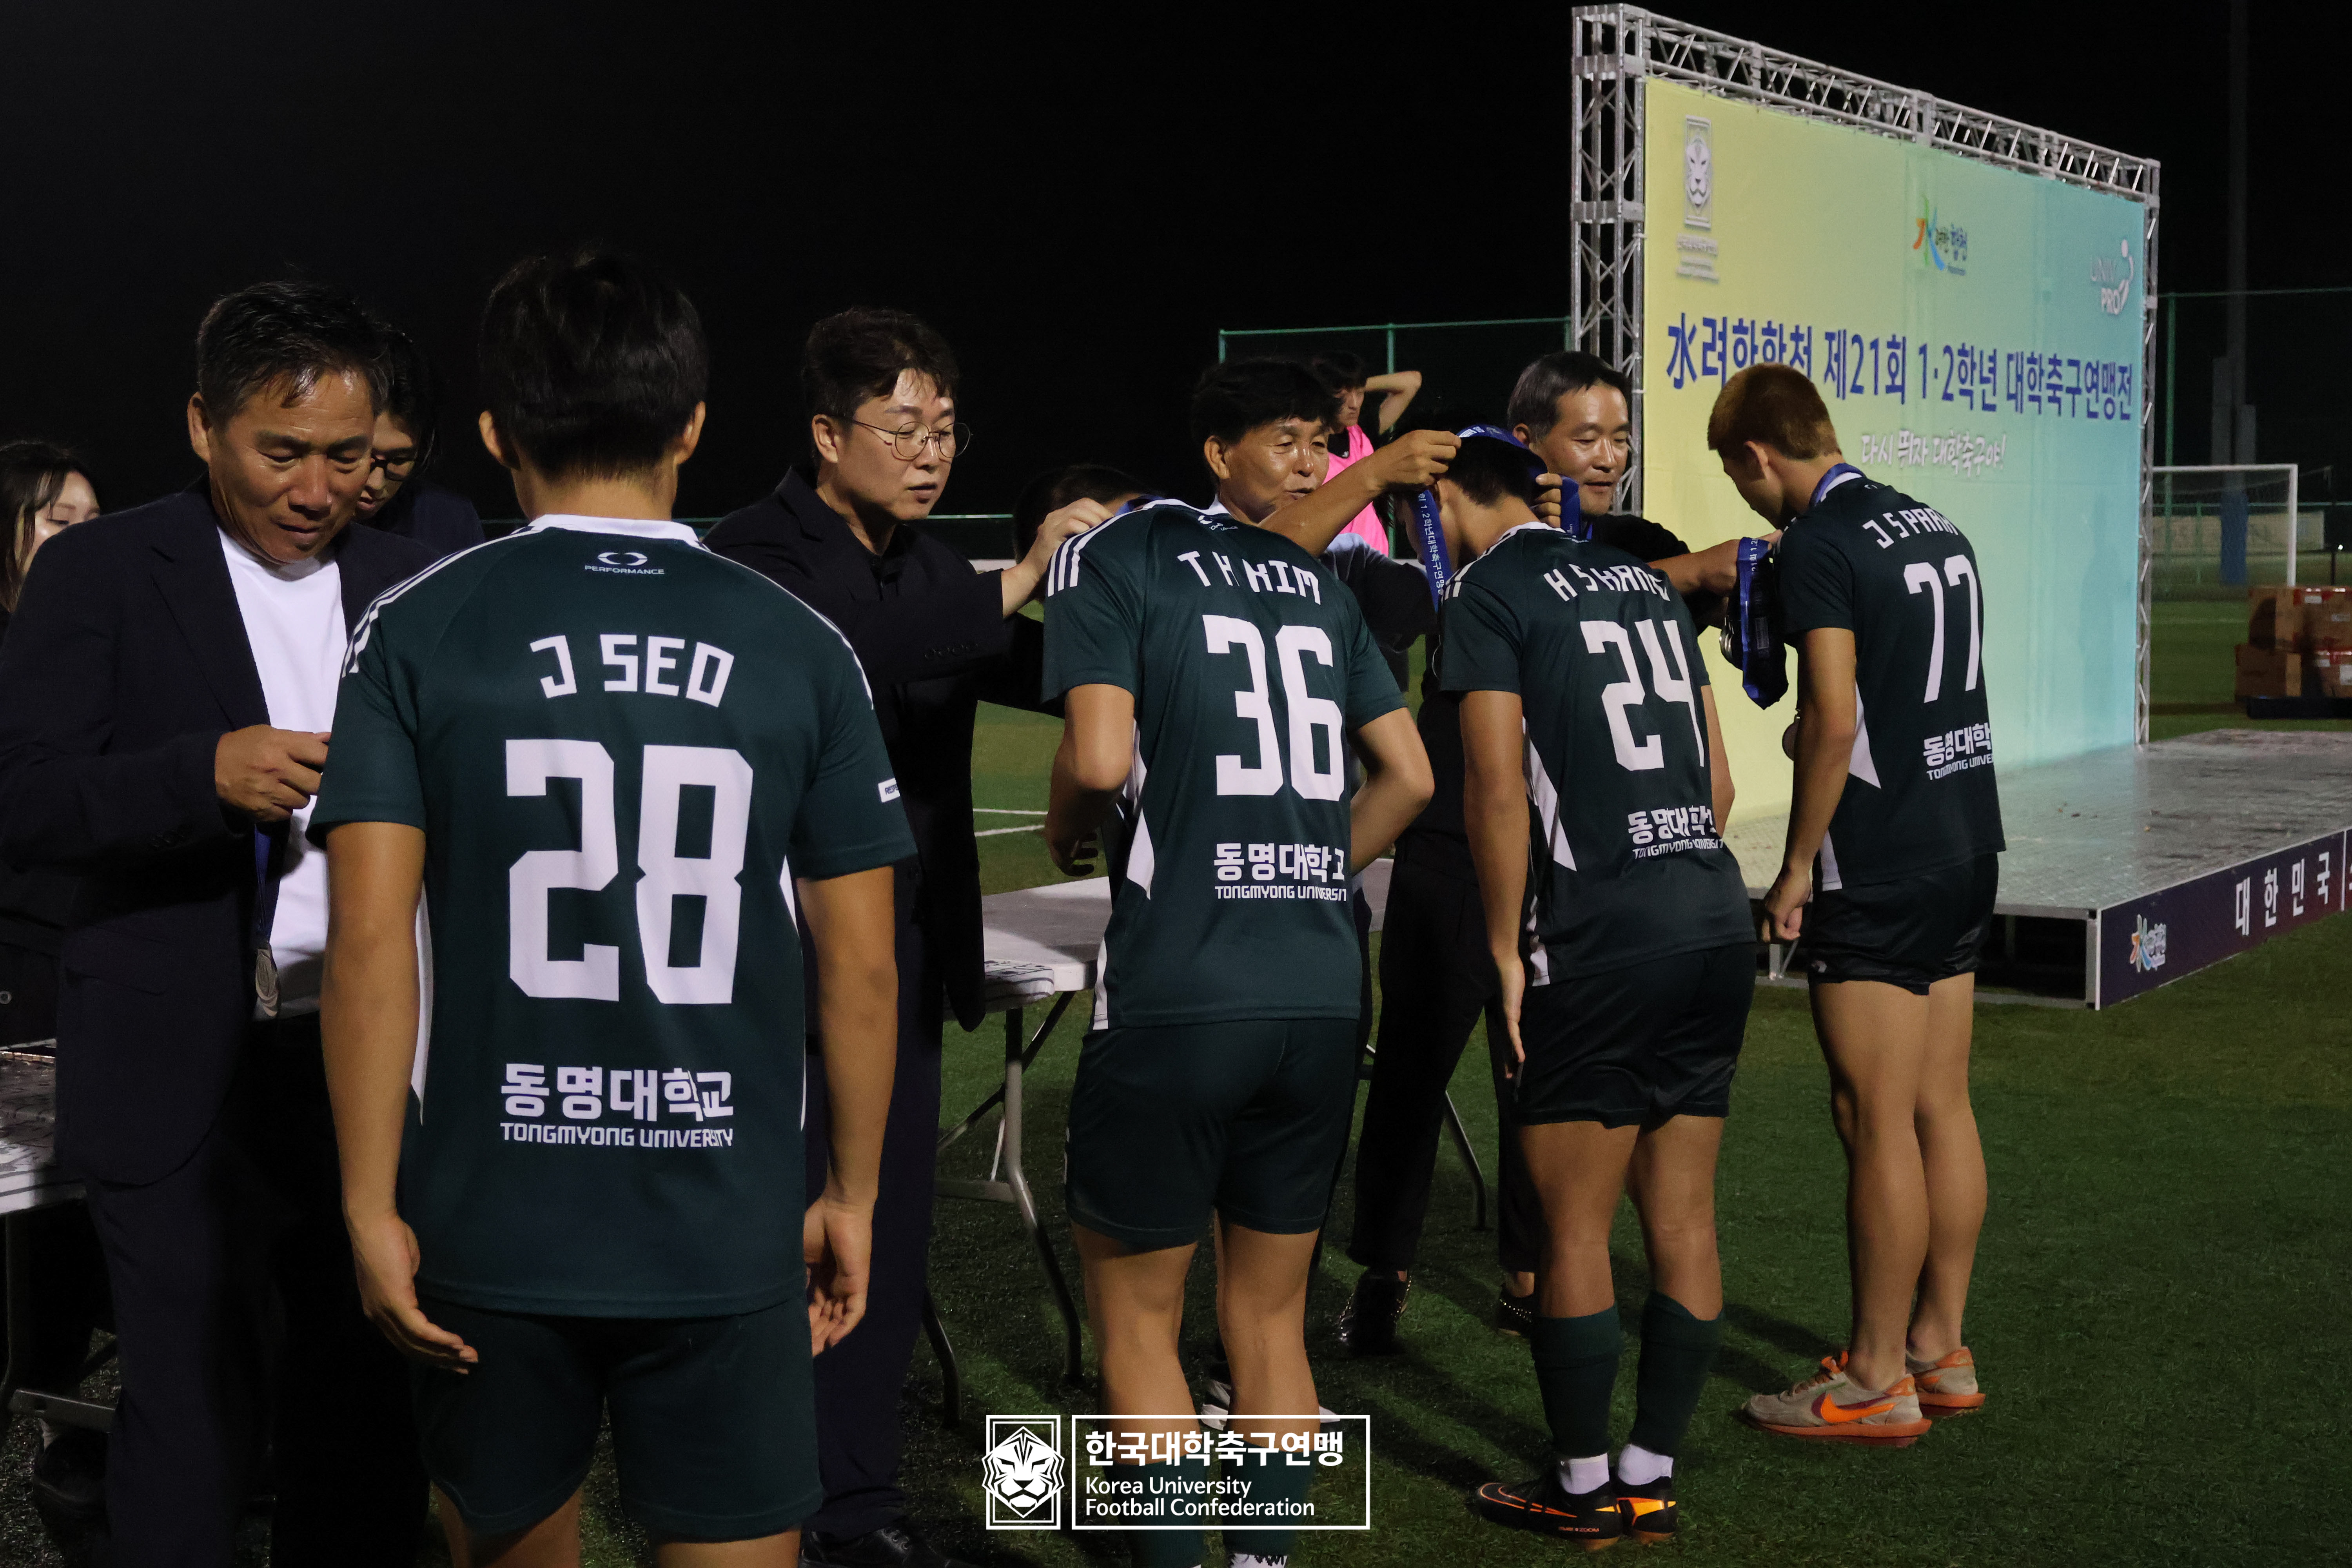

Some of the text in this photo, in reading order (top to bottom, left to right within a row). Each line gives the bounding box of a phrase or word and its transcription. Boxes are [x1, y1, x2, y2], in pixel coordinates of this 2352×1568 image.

[1824, 329, 1906, 405] 제21회
[2006, 351, 2132, 420] 대학축구연맹전
[1862, 434, 1893, 465] 다시
[1932, 430, 2007, 477] 대학축구야!
[1862, 508, 1959, 549] J S PARK
[584, 565, 665, 574] PERFORMANCE
[1177, 551, 1321, 606] T H KIM
[1543, 569, 1578, 602] H
[1568, 564, 1599, 591] S
[1904, 554, 1980, 704] 77
[530, 634, 735, 708] J SEO
[1580, 619, 1704, 771] 24
[1202, 614, 1345, 801] 36
[505, 738, 753, 1004] 28
[1632, 839, 1693, 859] TONGMYONG
[1215, 886, 1295, 899] TONGMYONG
[2235, 851, 2330, 936] 대한민국
[501, 1063, 734, 1122] 동명대학교
[500, 1123, 635, 1146] TONGMYONG
